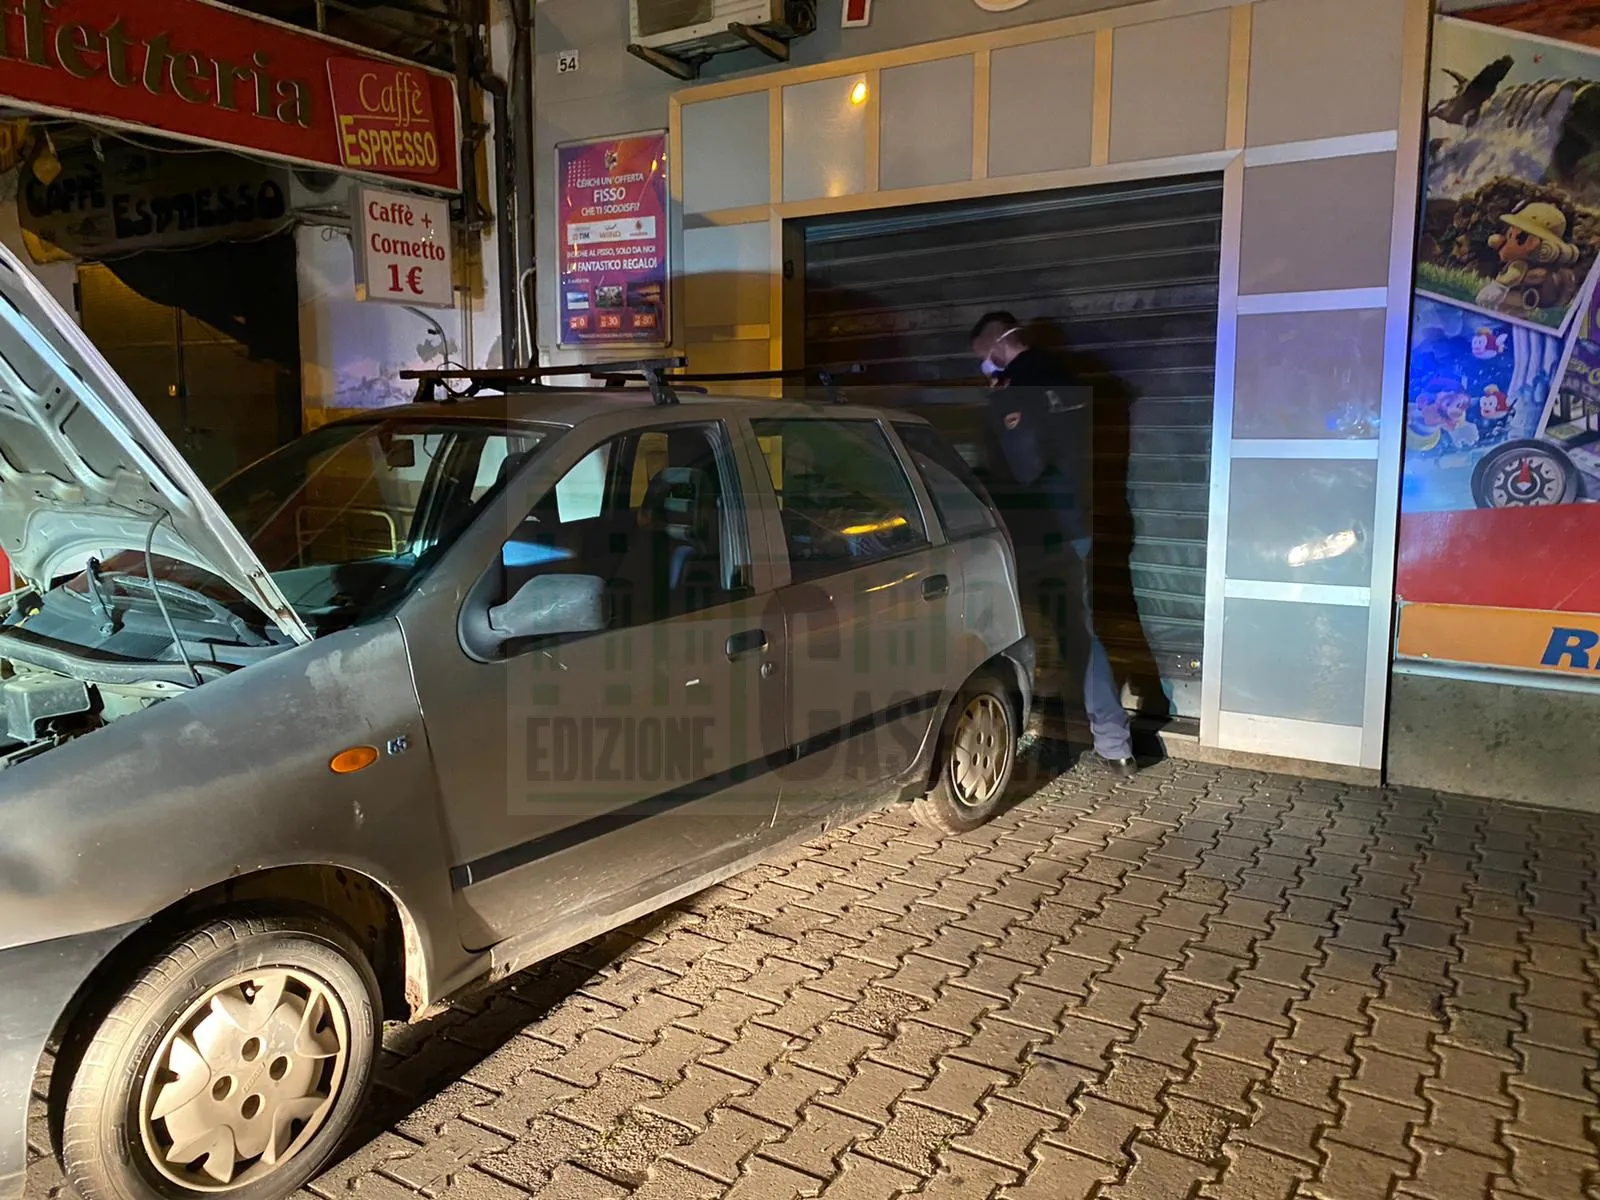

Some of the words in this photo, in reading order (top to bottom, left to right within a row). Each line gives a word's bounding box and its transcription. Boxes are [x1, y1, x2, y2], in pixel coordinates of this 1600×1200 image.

[0, 0, 312, 128] fetteria
[560, 57, 576, 71] 54
[359, 72, 424, 127] Caffè
[615, 173, 644, 184] OFFERTA
[594, 187, 626, 203] FISSO
[368, 201, 414, 226] Caffè
[581, 206, 596, 216] CHE
[371, 233, 446, 260] Cornetto
[615, 246, 632, 255] SOLO
[632, 246, 642, 254] DA
[643, 245, 656, 253] NOI
[577, 260, 621, 272] FANTASTICO
[622, 257, 657, 269] REGALO!
[387, 264, 424, 295] 1€
